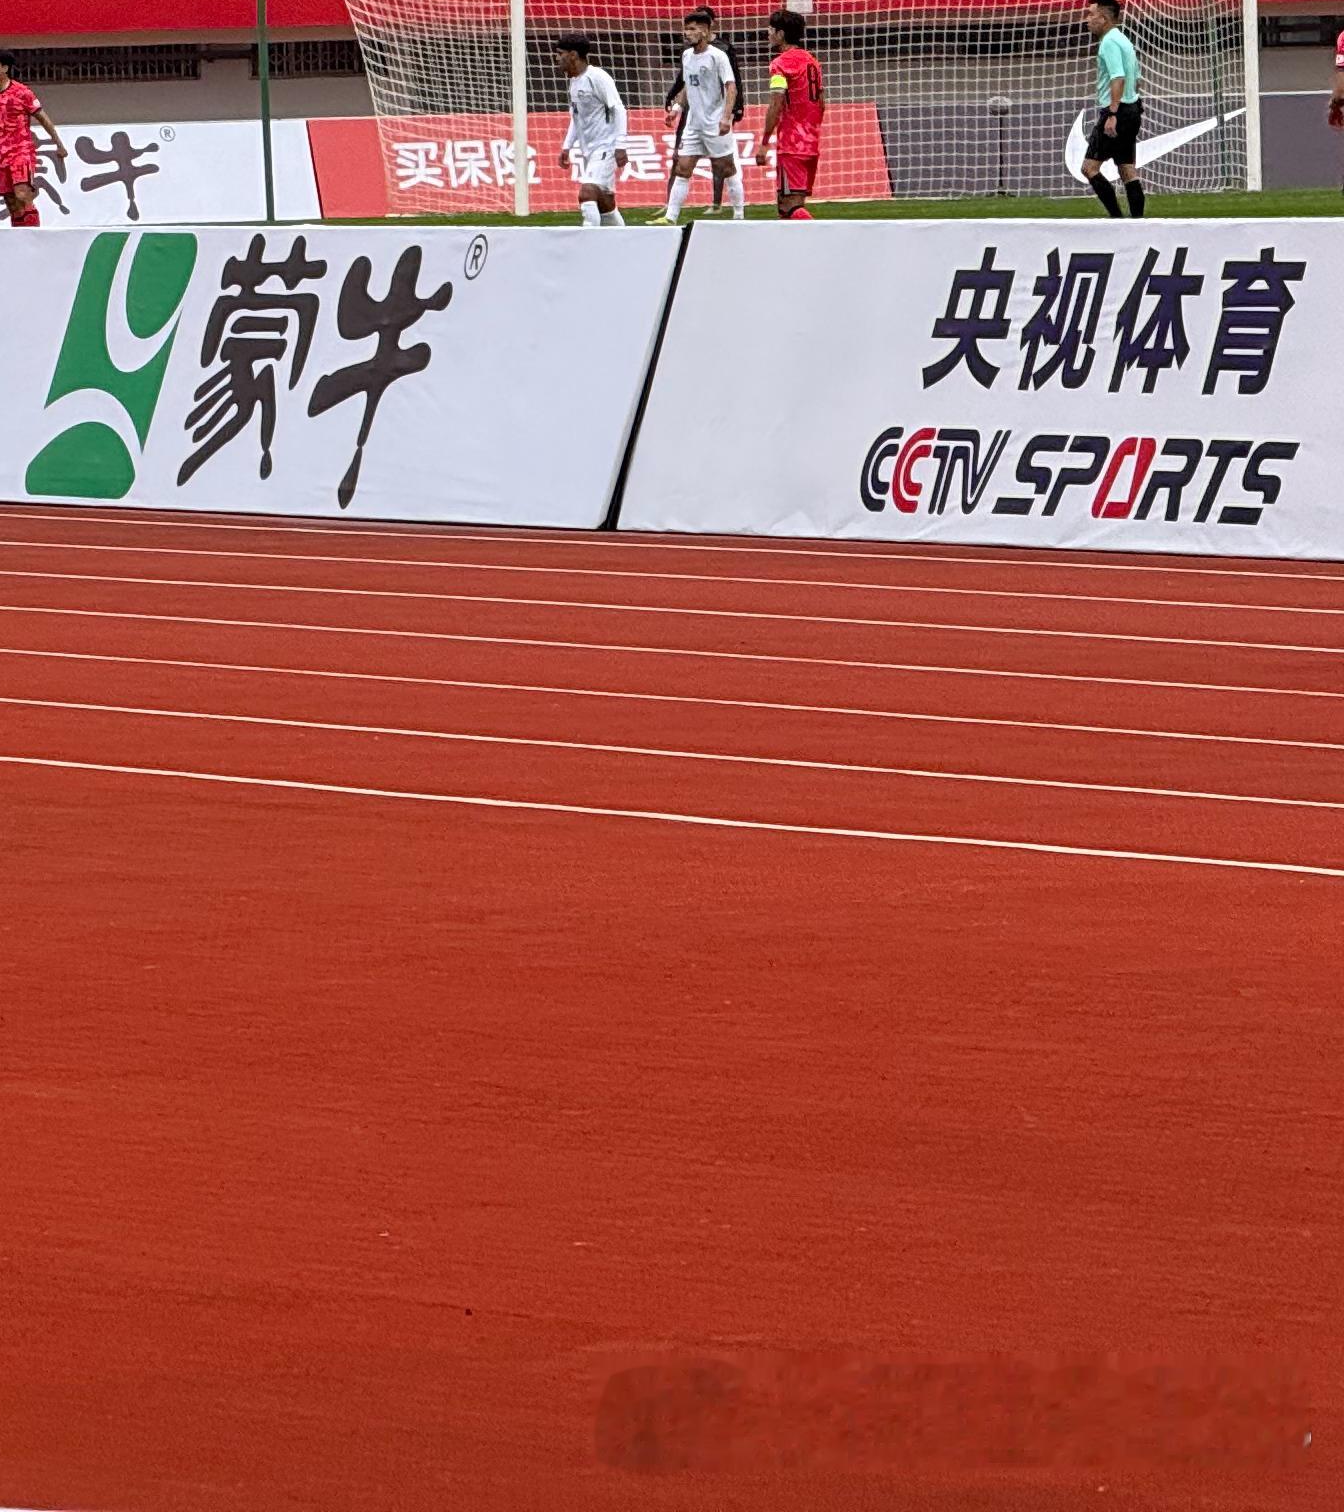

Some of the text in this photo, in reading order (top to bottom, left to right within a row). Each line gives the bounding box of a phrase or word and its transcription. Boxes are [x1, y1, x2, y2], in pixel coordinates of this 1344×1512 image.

[176, 232, 454, 510] 蒙牛
[921, 246, 1308, 396] 央视体育
[860, 426, 1302, 526] CCTV SPORTS
